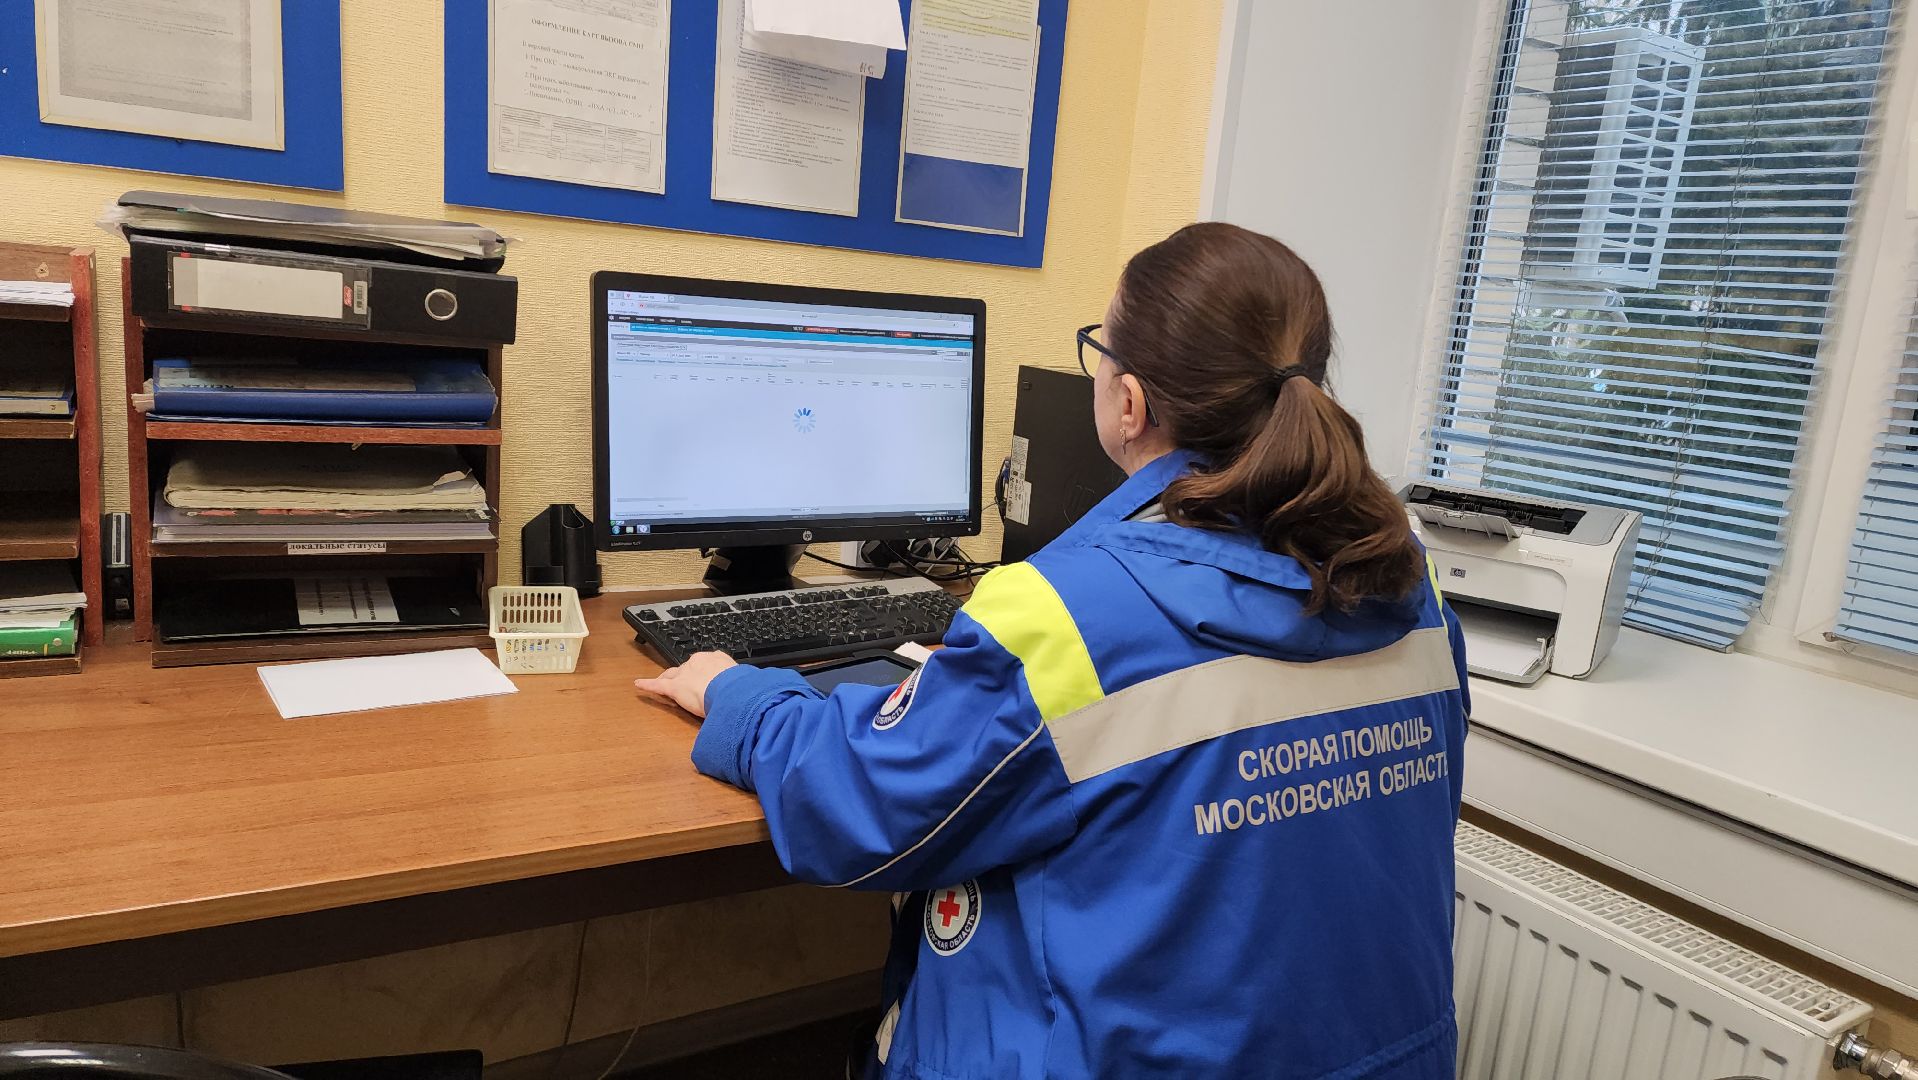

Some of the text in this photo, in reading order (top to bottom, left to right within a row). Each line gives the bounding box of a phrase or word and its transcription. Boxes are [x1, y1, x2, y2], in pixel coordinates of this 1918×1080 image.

[347, 542, 386, 550] статусы
[1238, 716, 1433, 782] СКОРАЯ ПОМОЩЬ
[1194, 770, 1371, 835] МОСКОВСКАЯ
[949, 914, 976, 949] ОБЛАСТЬ
